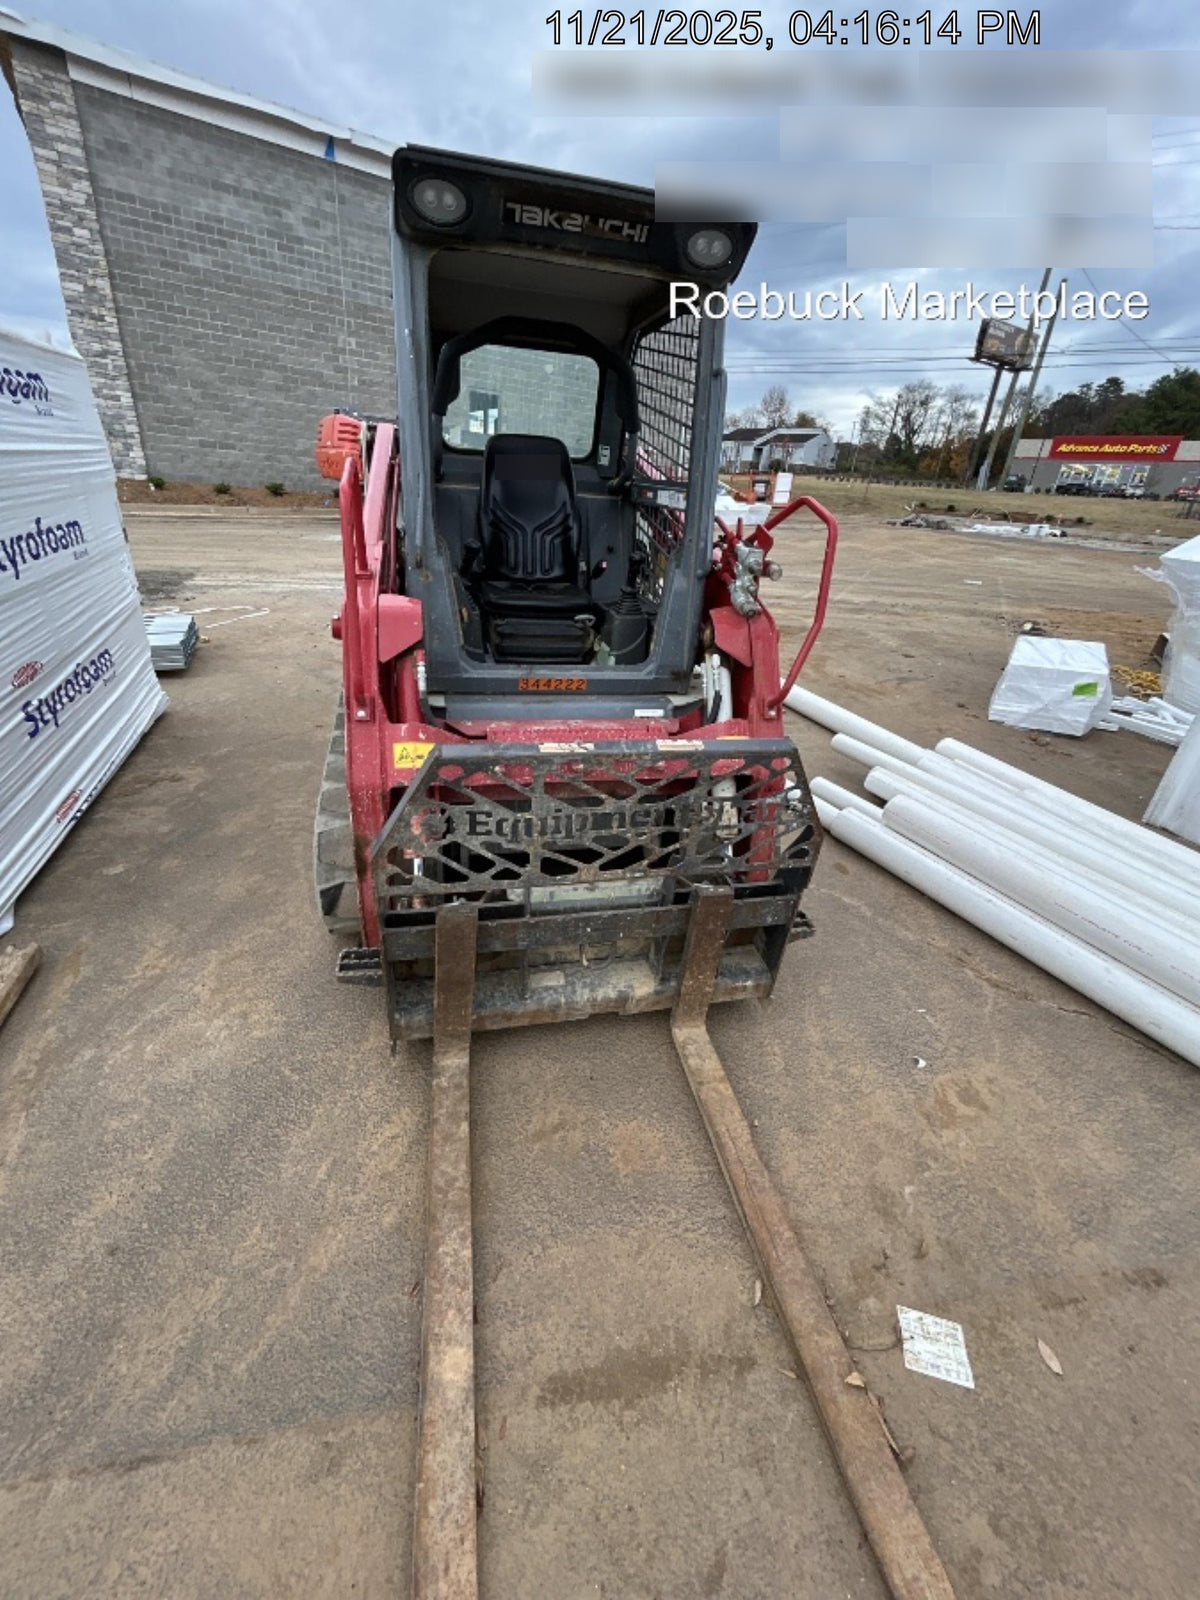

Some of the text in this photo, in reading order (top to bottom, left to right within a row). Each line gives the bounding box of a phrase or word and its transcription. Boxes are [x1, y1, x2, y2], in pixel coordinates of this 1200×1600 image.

[1056, 443, 1159, 454] Advance Auto Parts
[519, 677, 586, 690] 344222
[22, 648, 113, 738] Styrofoam
